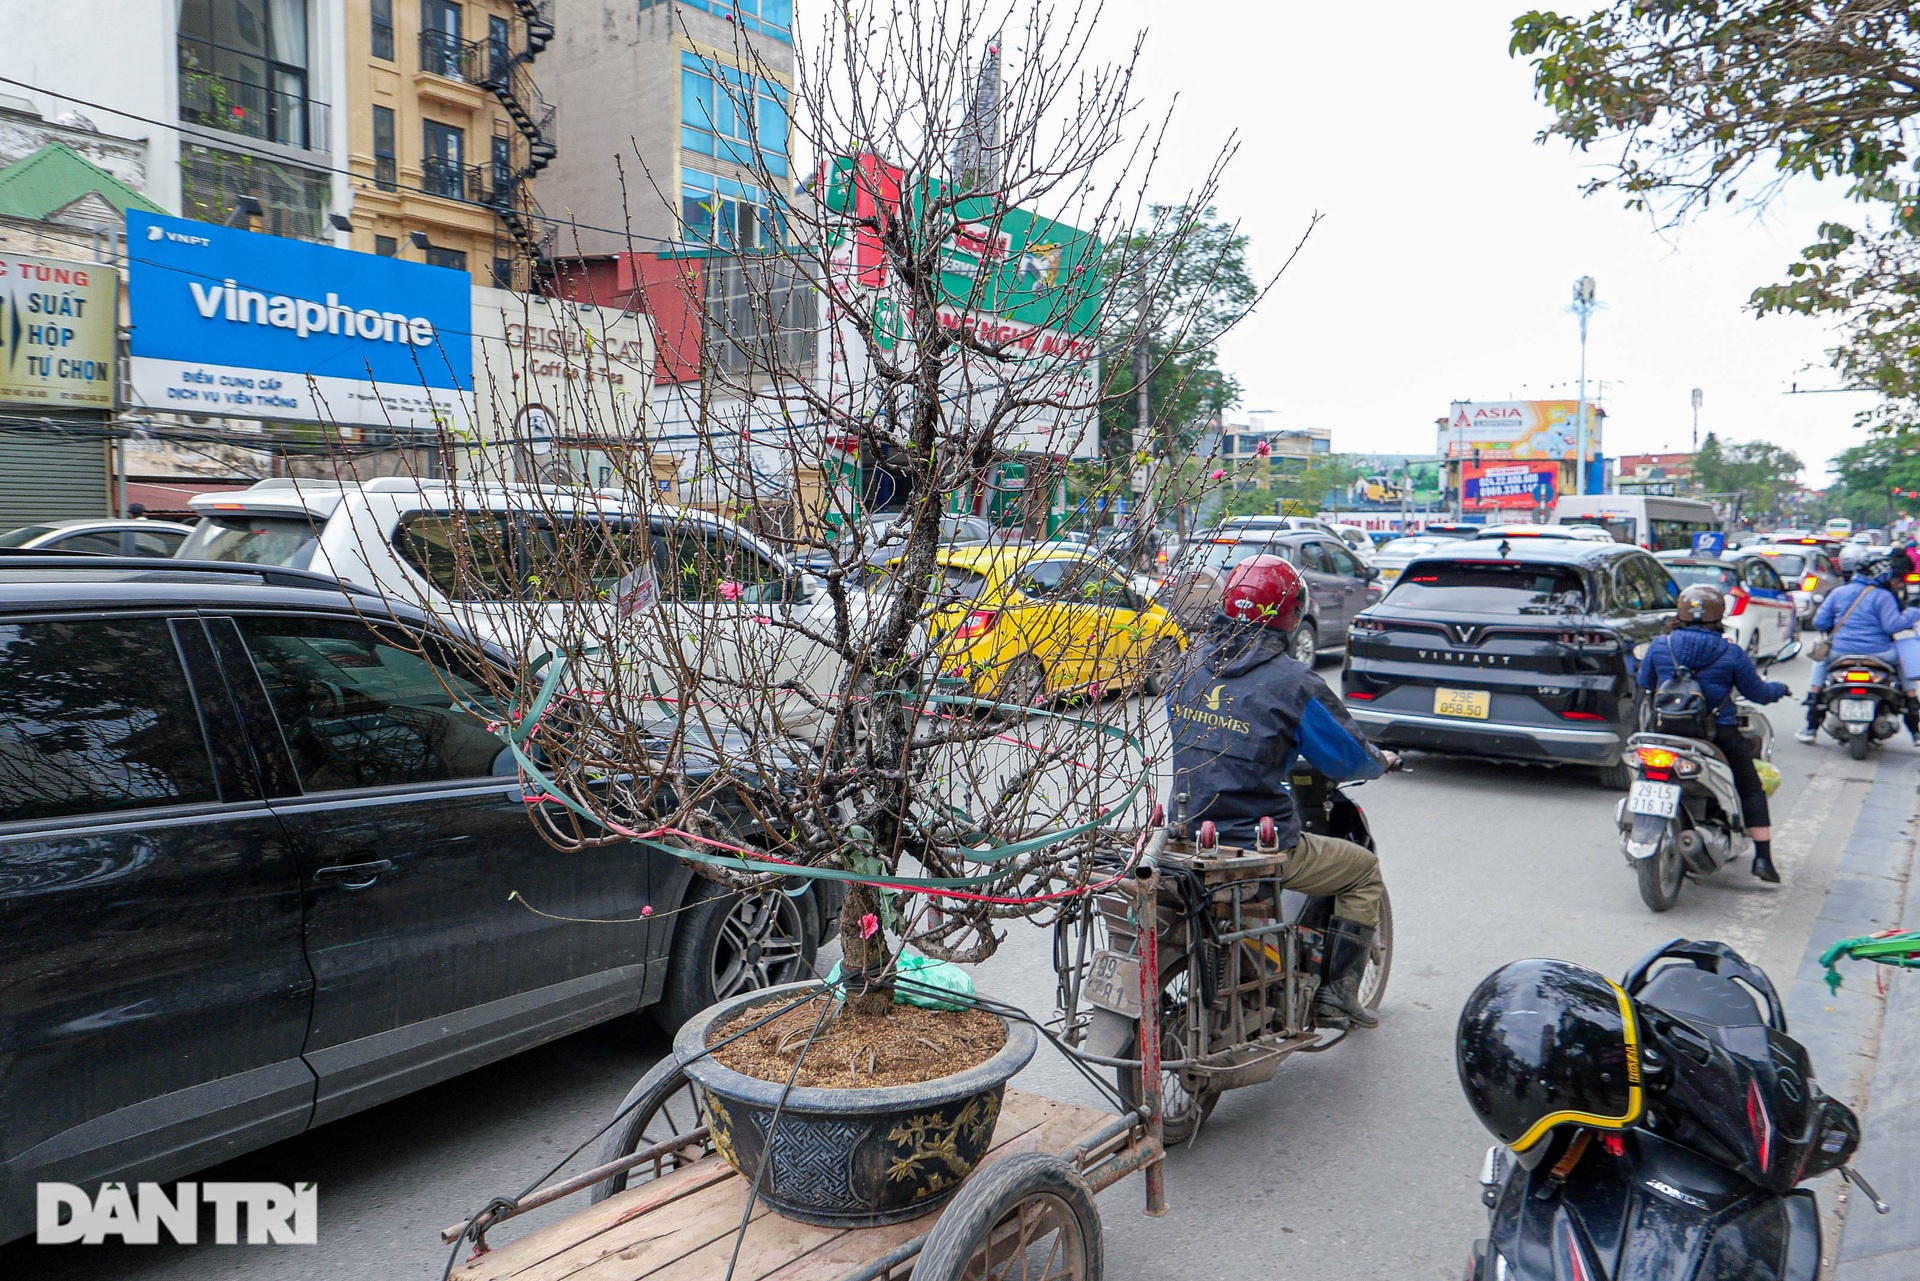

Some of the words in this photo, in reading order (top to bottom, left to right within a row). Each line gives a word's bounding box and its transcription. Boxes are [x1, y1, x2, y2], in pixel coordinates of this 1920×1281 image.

[166, 231, 211, 247] VNPT
[17, 262, 89, 287] TÙNG
[28, 289, 87, 318] SUẤT
[188, 278, 434, 347] vinaphone
[28, 321, 74, 351] HỘP
[58, 358, 108, 385] CHỌN
[598, 367, 624, 385] Tea
[219, 375, 254, 389] CUNG
[167, 387, 199, 401] DỊCH
[202, 390, 220, 403] VỤ
[256, 395, 298, 408] THÔNG
[1474, 408, 1522, 418] ASIA
[1418, 650, 1511, 665] VINFAST
[1451, 691, 1474, 703] 29E
[1440, 702, 1482, 716] 058.50
[1175, 704, 1250, 734] VINHOMES
